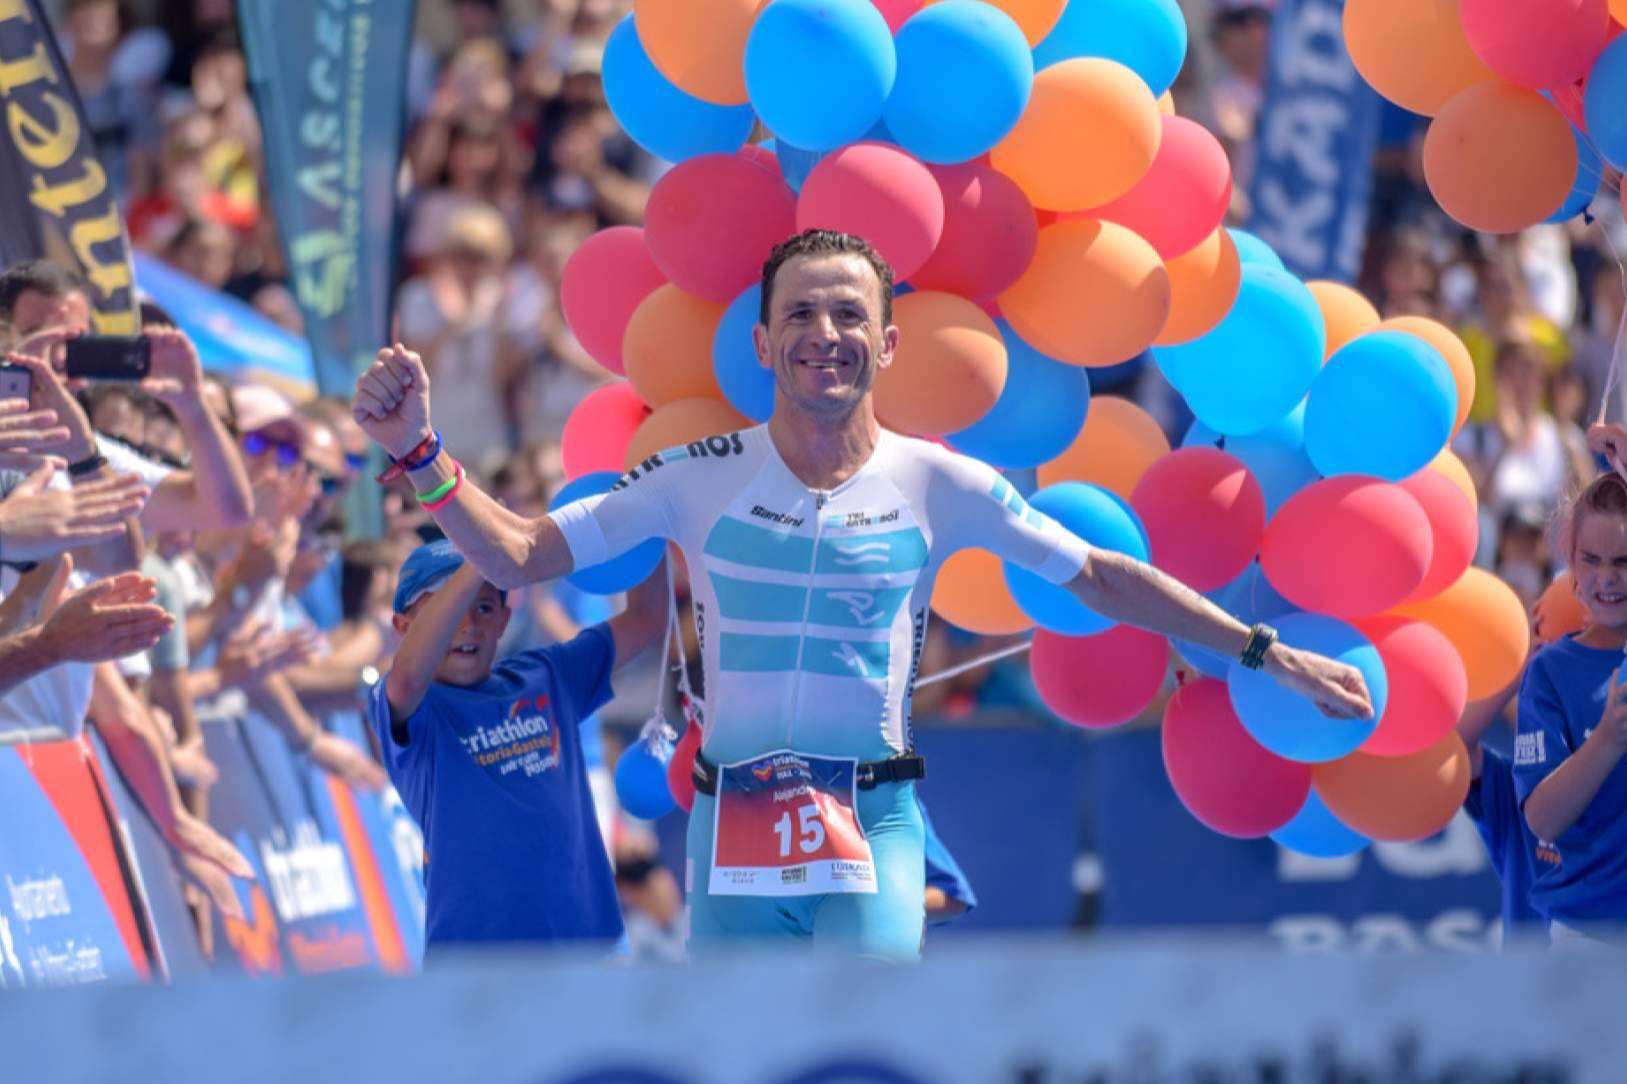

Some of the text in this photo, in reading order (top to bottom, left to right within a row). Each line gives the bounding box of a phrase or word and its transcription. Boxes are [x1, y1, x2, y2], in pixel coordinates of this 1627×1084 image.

[751, 504, 804, 527] Santini
[468, 716, 549, 753] riathlon
[774, 803, 826, 857] 15
